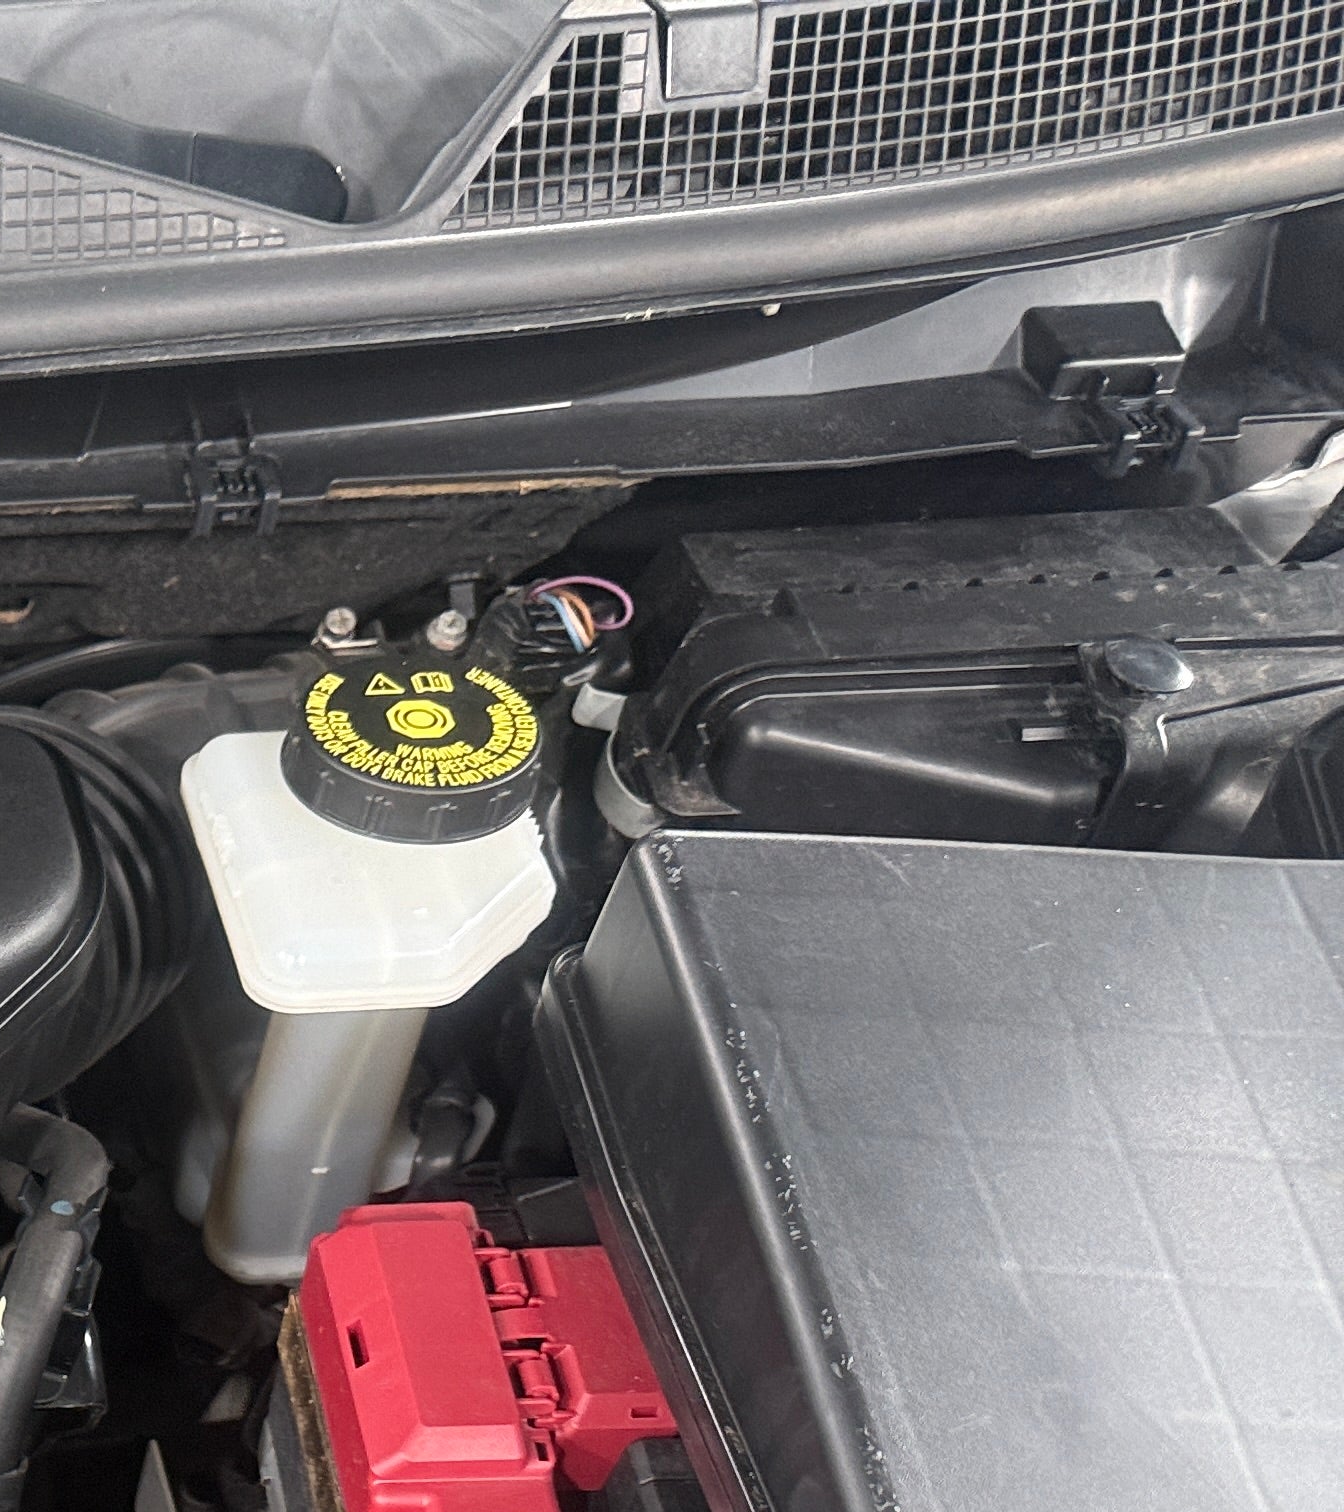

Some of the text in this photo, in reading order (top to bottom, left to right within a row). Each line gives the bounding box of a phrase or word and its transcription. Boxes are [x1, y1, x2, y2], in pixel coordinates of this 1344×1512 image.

[465, 666, 533, 717] CONTAINER
[323, 739, 349, 757] OR
[326, 711, 357, 743] CLEAN
[344, 740, 402, 769] FILLER
[400, 758, 435, 774] CAP
[436, 747, 497, 774] BEFORE
[395, 741, 474, 762] WARNING
[341, 751, 383, 776] DOT4
[479, 753, 522, 780] FROM
[382, 767, 436, 787] BRAKE
[437, 768, 485, 787] FLUID
